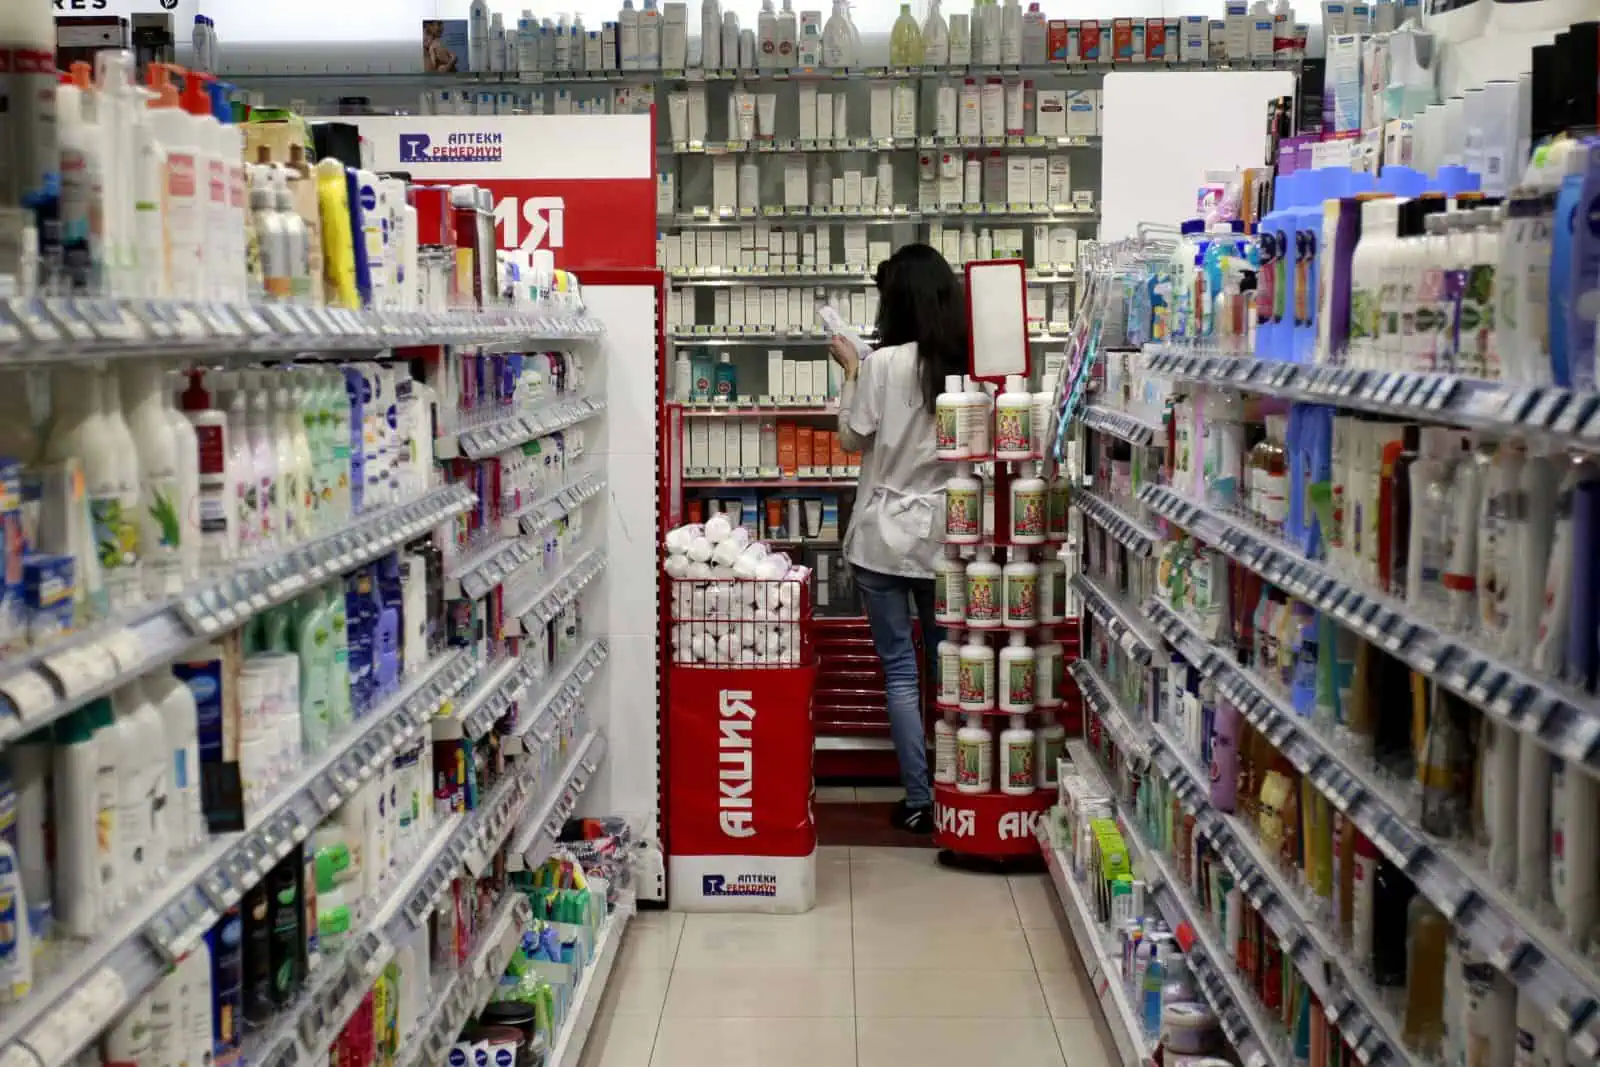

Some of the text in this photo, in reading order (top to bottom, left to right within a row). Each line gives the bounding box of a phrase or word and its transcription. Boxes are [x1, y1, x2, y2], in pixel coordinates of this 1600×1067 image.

[448, 133, 502, 145] АПТЕКИ
[719, 688, 757, 838] АКЦИЯ
[737, 874, 777, 883] АПТЕКИ
